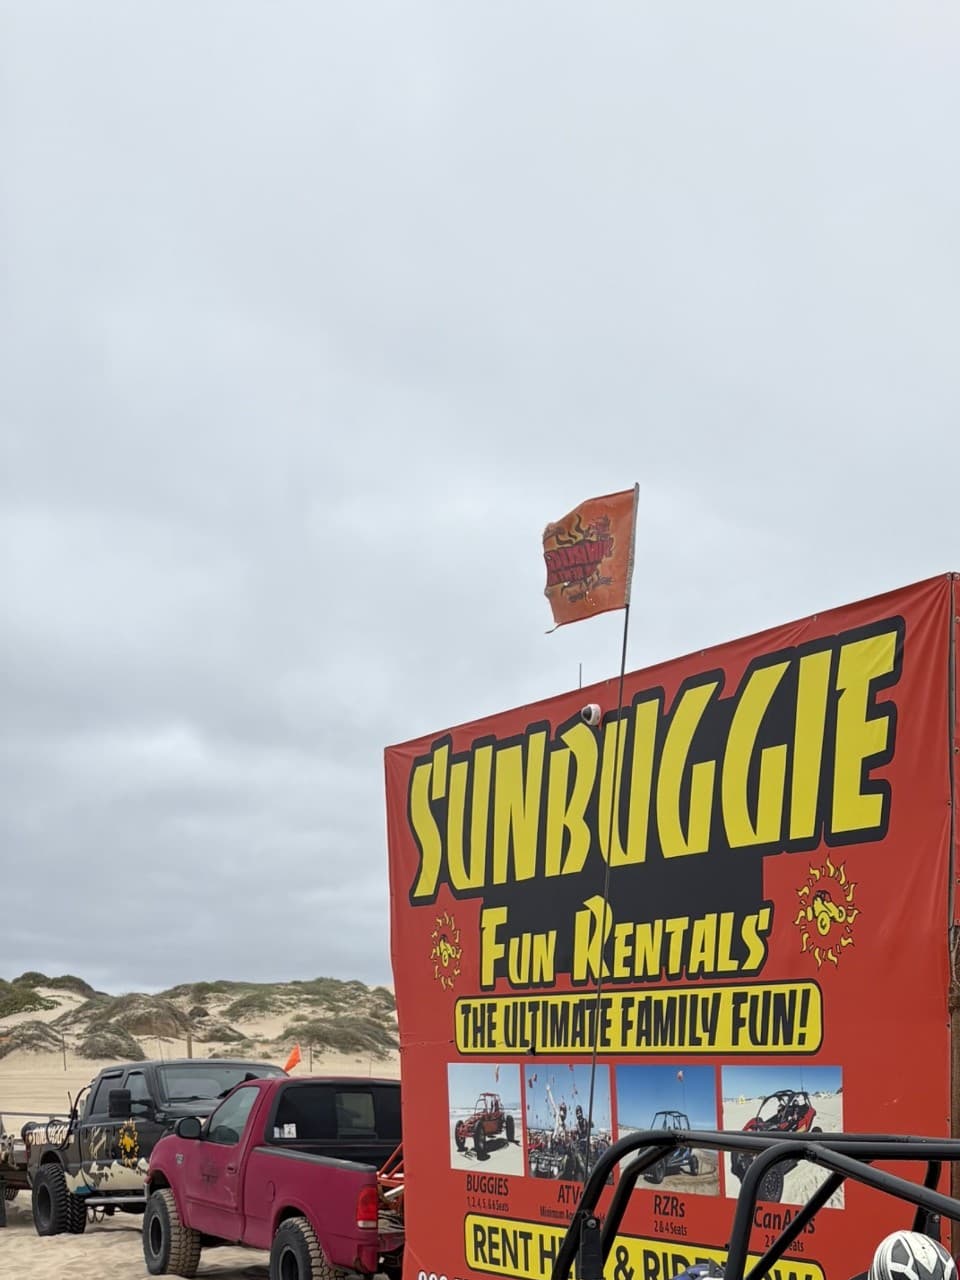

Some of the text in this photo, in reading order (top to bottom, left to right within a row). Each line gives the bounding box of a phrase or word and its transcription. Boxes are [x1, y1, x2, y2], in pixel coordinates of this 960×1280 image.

[409, 630, 898, 898] SUNBUGGIE
[480, 894, 770, 988] FUN RENTALS
[460, 987, 811, 1049] THE ULTIMATE FAMILY FUN!
[466, 1174, 509, 1196] BUGGIES
[654, 1194, 685, 1218] RZRs
[473, 1223, 533, 1272] RENT
[654, 1220, 659, 1233] 2
[665, 1221, 670, 1233] 4
[670, 1222, 688, 1237] Seats
